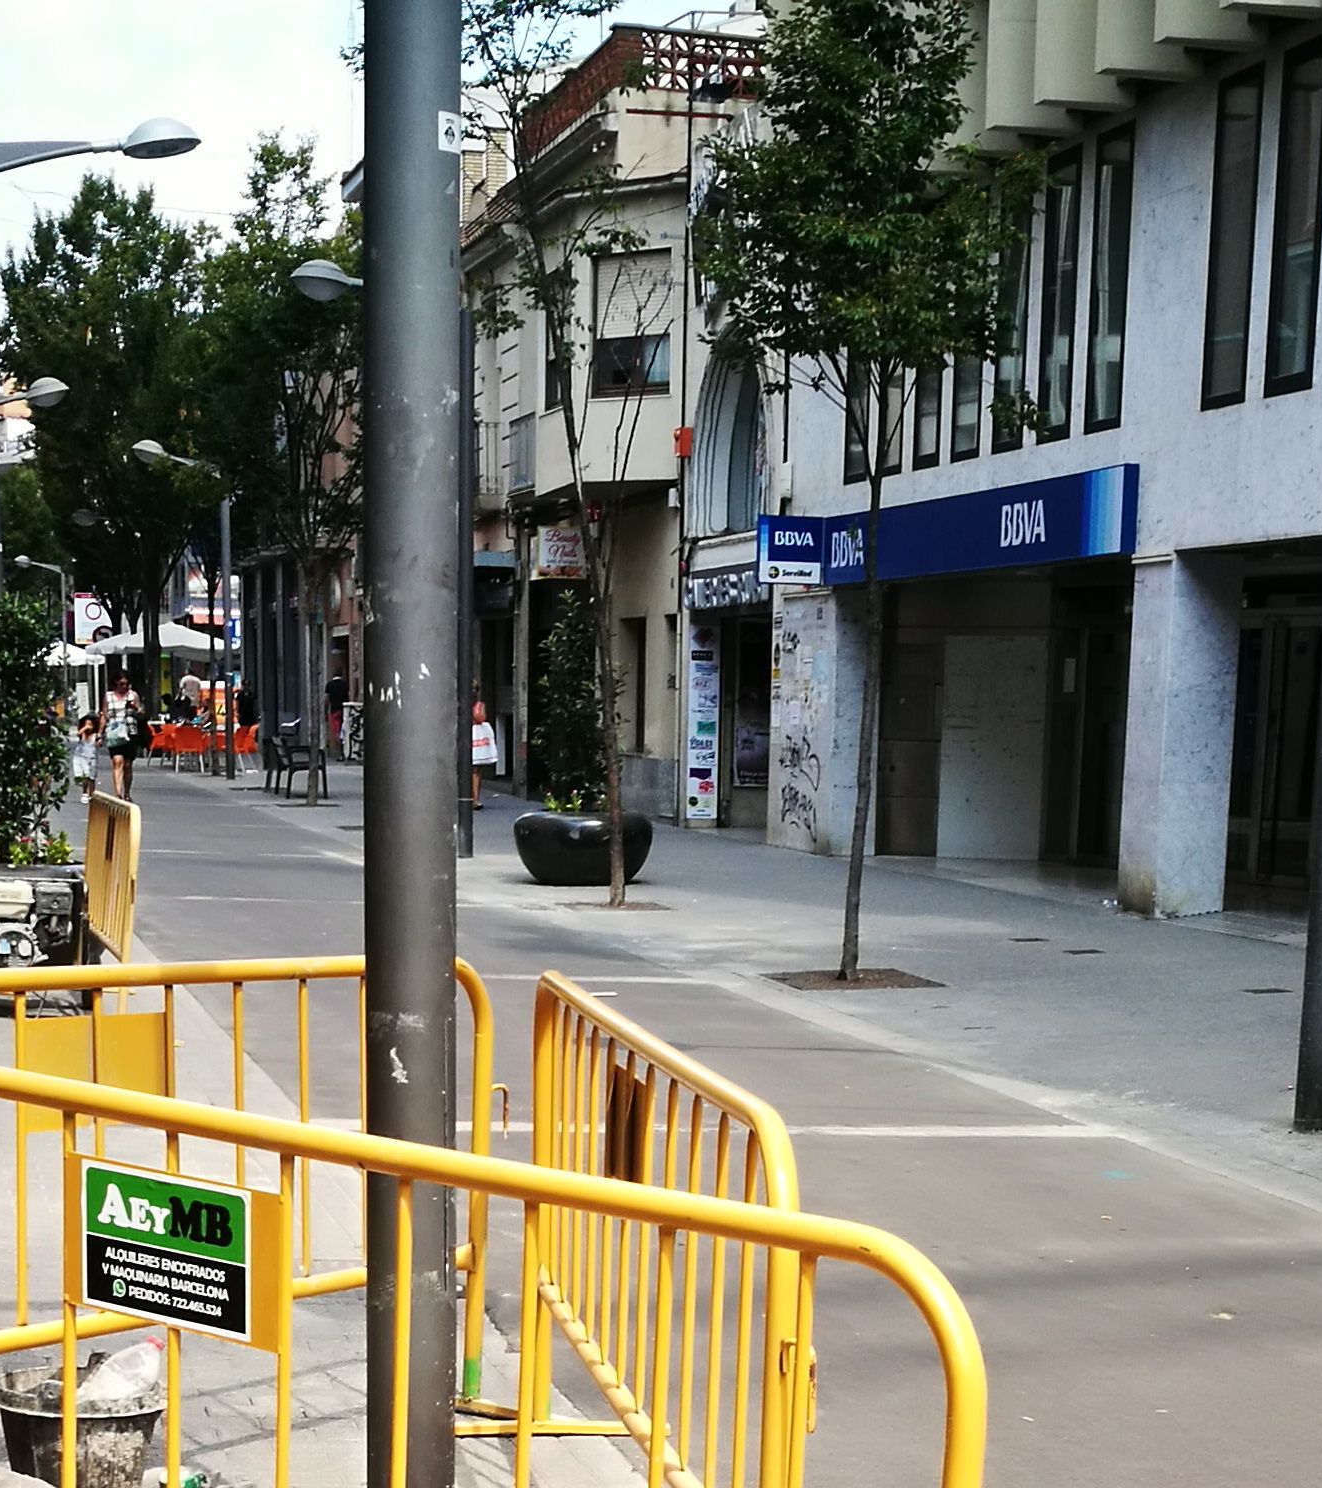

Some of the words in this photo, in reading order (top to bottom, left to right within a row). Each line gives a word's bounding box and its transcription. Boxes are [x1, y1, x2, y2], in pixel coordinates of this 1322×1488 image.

[774, 530, 814, 547] BBVA
[1000, 498, 1046, 548] BBVA
[830, 527, 864, 569] BBVA
[102, 1262, 109, 1276] Y
[110, 1263, 170, 1289] MAQUINARIA
[170, 1276, 230, 1302] BARCELONA
[105, 1246, 161, 1269] ALQUILERES
[161, 1254, 226, 1283] ENCOFRADOS
[128, 1284, 171, 1306] PEDIDOS:
